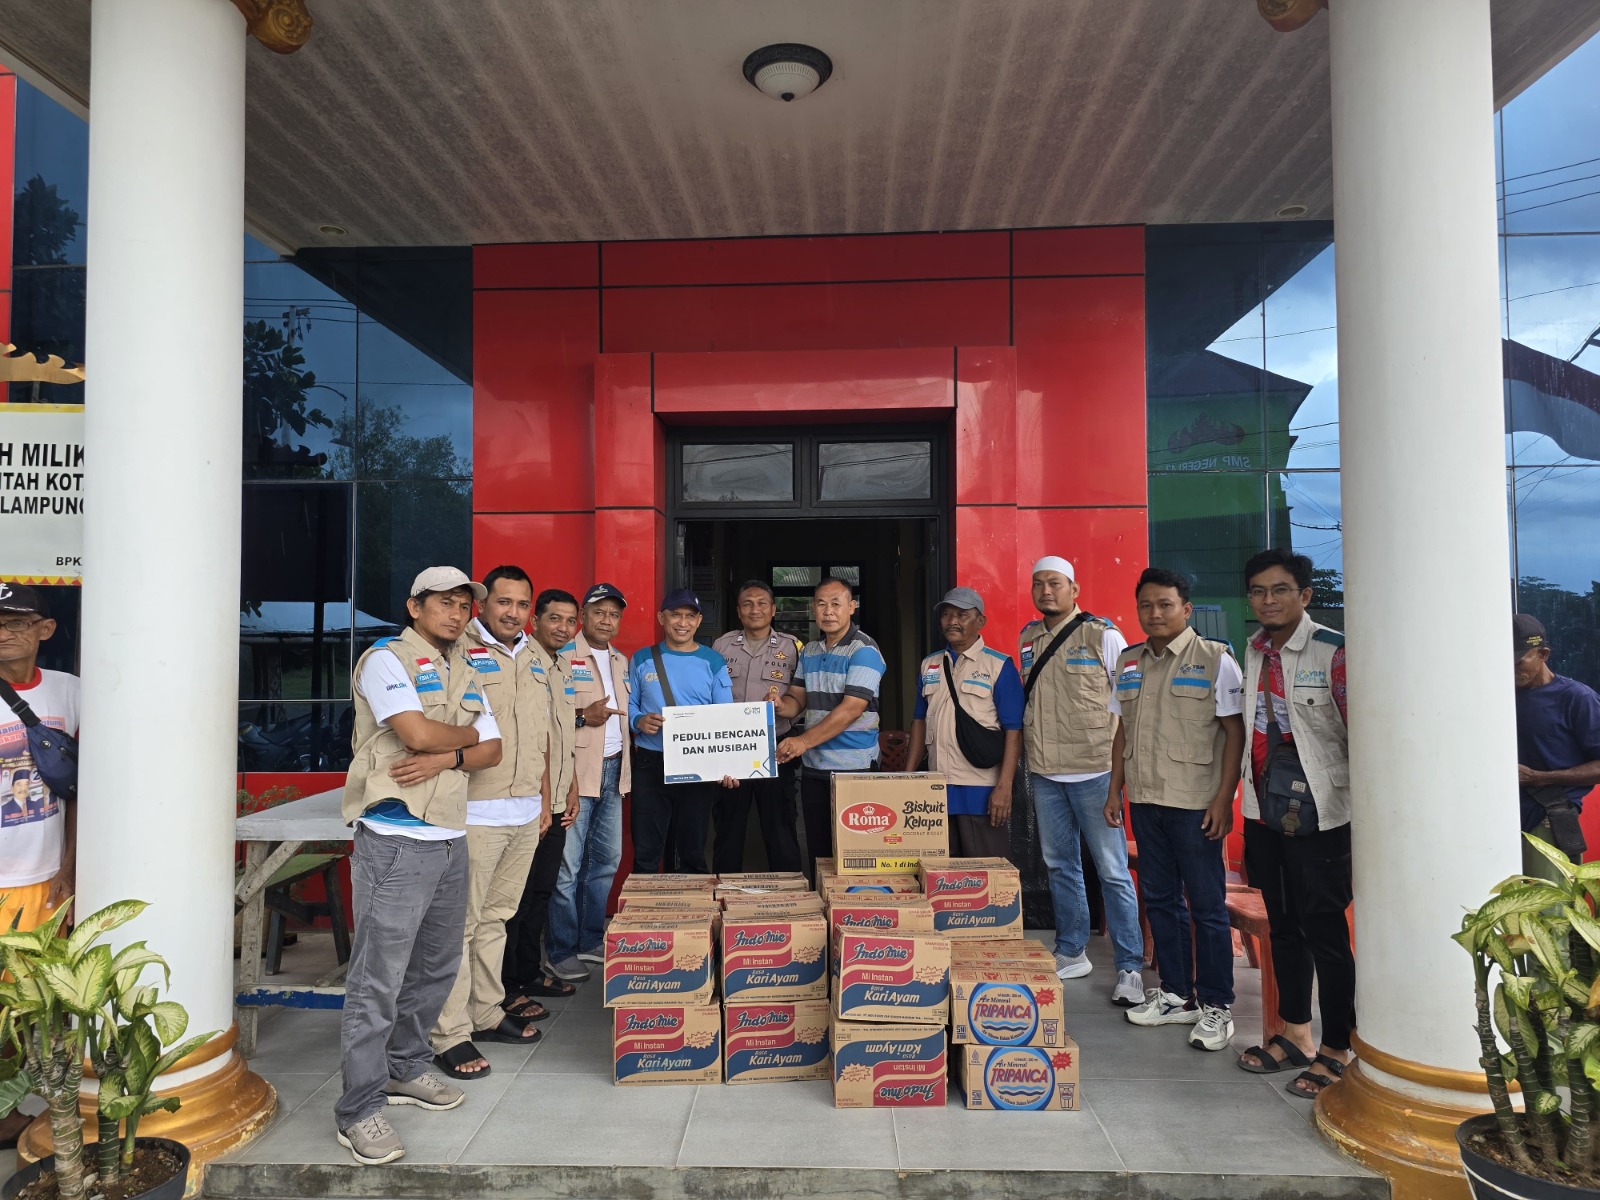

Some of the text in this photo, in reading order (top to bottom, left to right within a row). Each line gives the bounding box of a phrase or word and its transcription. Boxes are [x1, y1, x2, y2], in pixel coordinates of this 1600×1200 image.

[22, 443, 84, 467] MILIK
[0, 472, 84, 491] TAH KOT
[673, 729, 766, 742] PEDULI BENCANA
[682, 743, 757, 755] DAN MUSIBAH
[902, 800, 945, 814] Biskuit
[848, 812, 890, 826] Roma
[904, 815, 943, 831] Kelapa
[947, 915, 995, 927] Kari Ayam
[746, 973, 799, 985] Kari Ayam
[871, 973, 893, 982] Instan
[628, 980, 681, 992] Kari Ayam
[864, 990, 920, 1005] Kari Ayam
[974, 1003, 1032, 1021] TRIPANCA
[865, 1041, 922, 1055] Kari Ayam
[637, 1058, 691, 1070] Kari Ayam
[749, 1054, 802, 1066] Kari Ayam
[990, 1068, 1048, 1086] TRIPANCA
